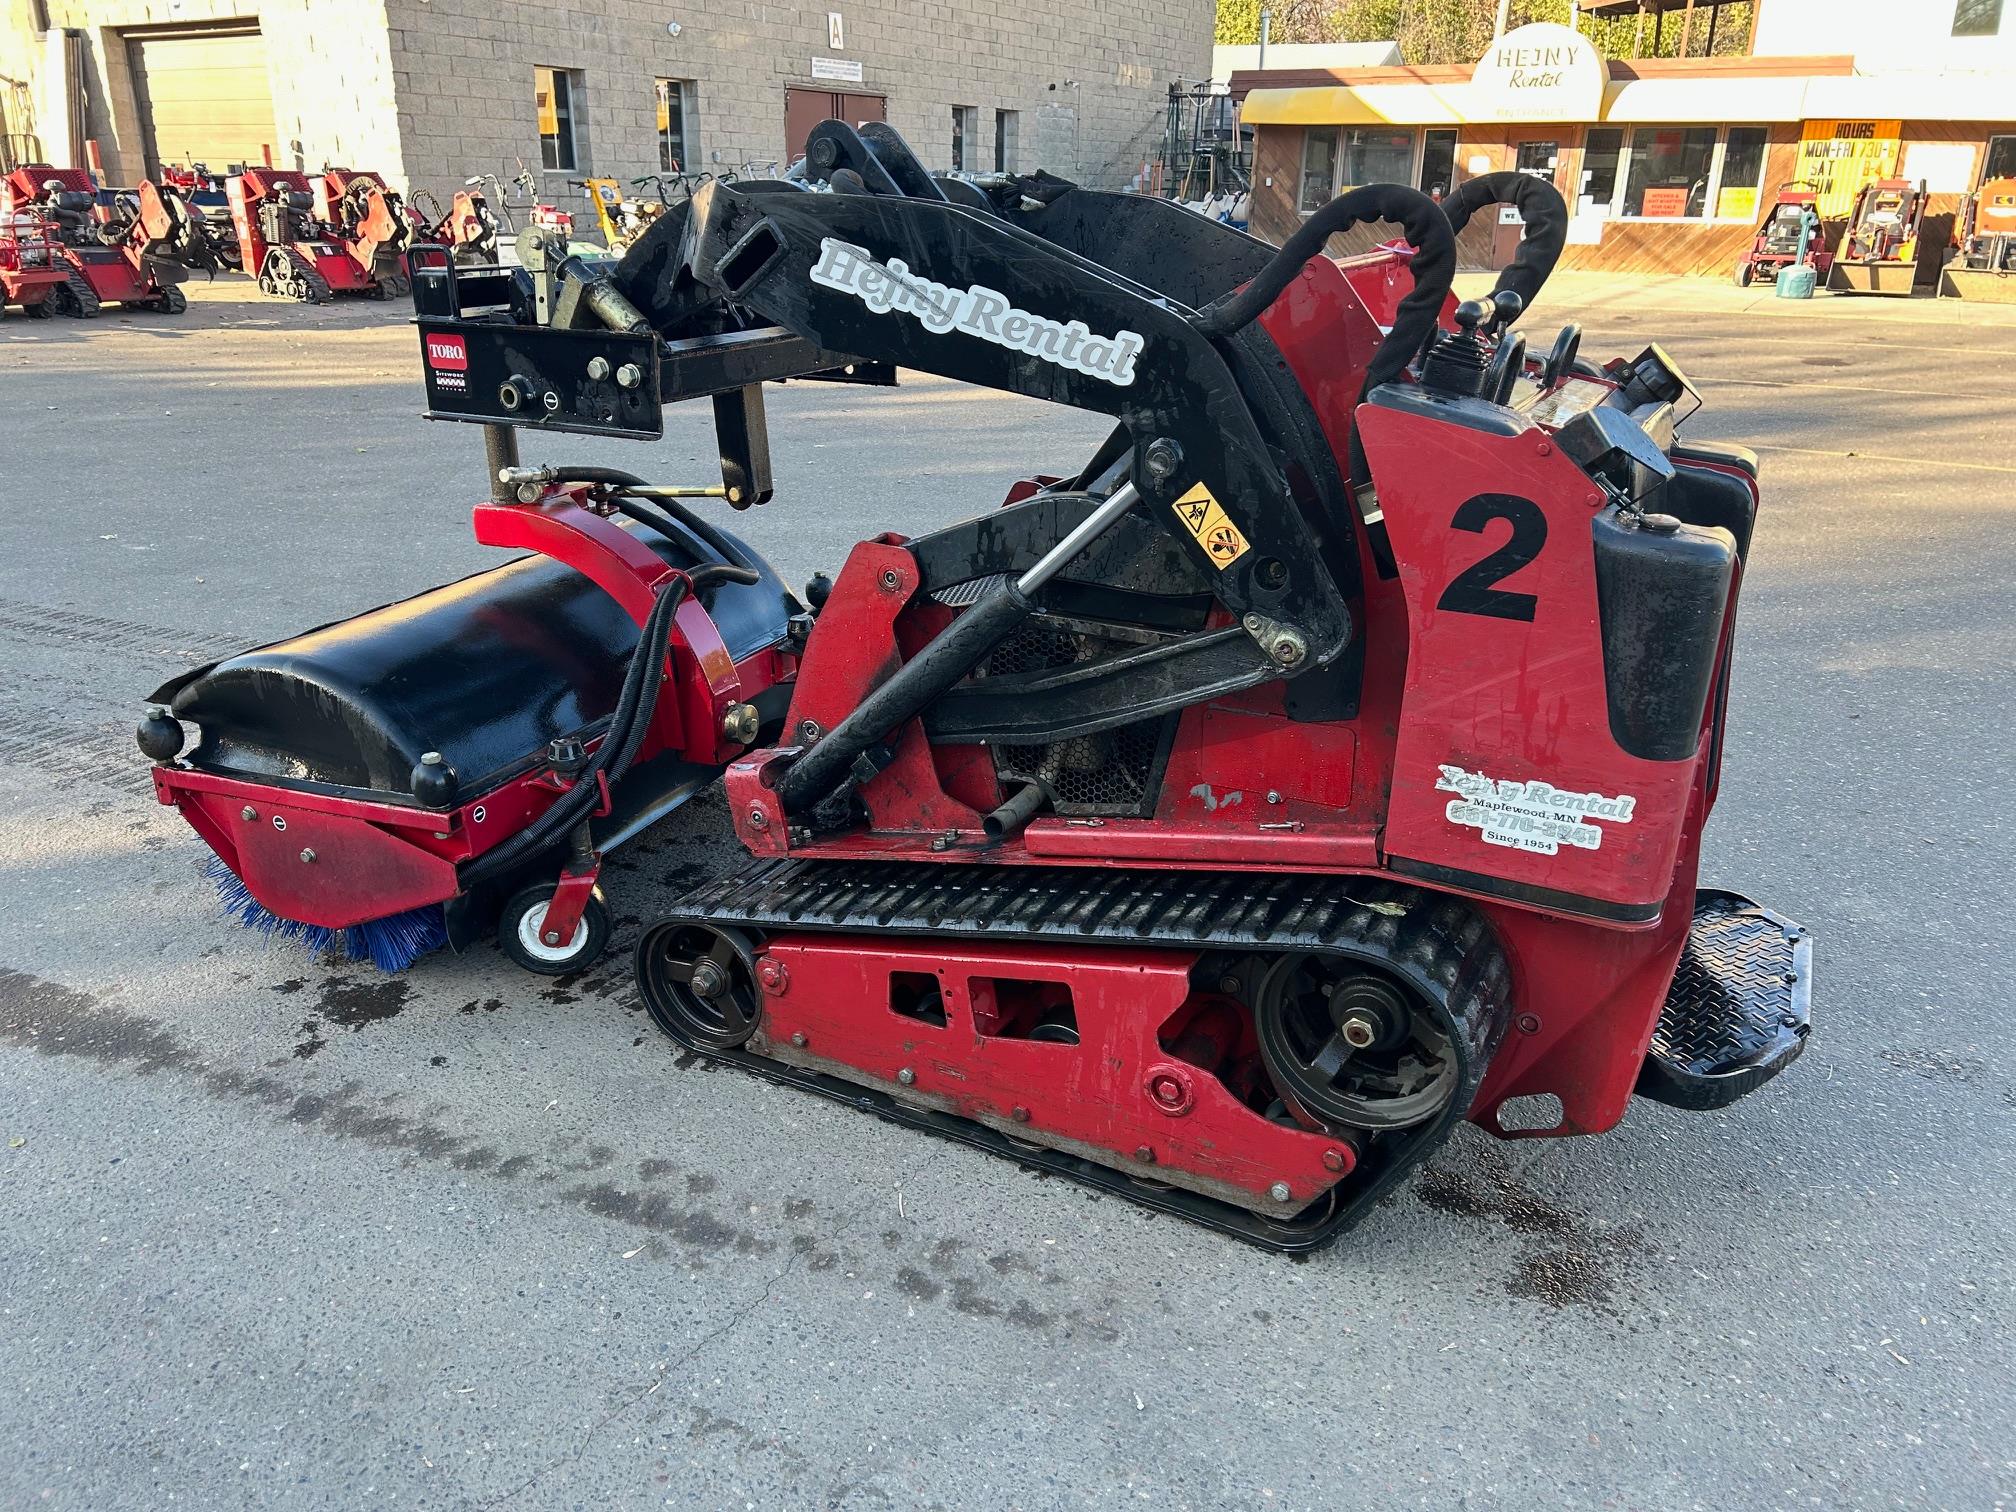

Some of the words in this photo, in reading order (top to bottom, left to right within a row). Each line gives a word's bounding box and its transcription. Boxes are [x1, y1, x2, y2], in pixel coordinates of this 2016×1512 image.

[832, 17, 842, 46] A
[1496, 46, 1579, 67] HEJNY
[1508, 69, 1564, 88] Rental
[1835, 122, 1876, 139] HOURS
[1810, 160, 1836, 176] SAT
[1808, 178, 1834, 194] SUN
[816, 242, 961, 327] Hejny
[961, 291, 1137, 379] Rental
[1436, 493, 1548, 622] 2
[1473, 798, 1550, 821] Maplewood,
[1553, 813, 1578, 824] MN
[1524, 784, 1634, 819] Rental
[1486, 830, 1520, 844] Since
[1523, 838, 1553, 851] 1954
